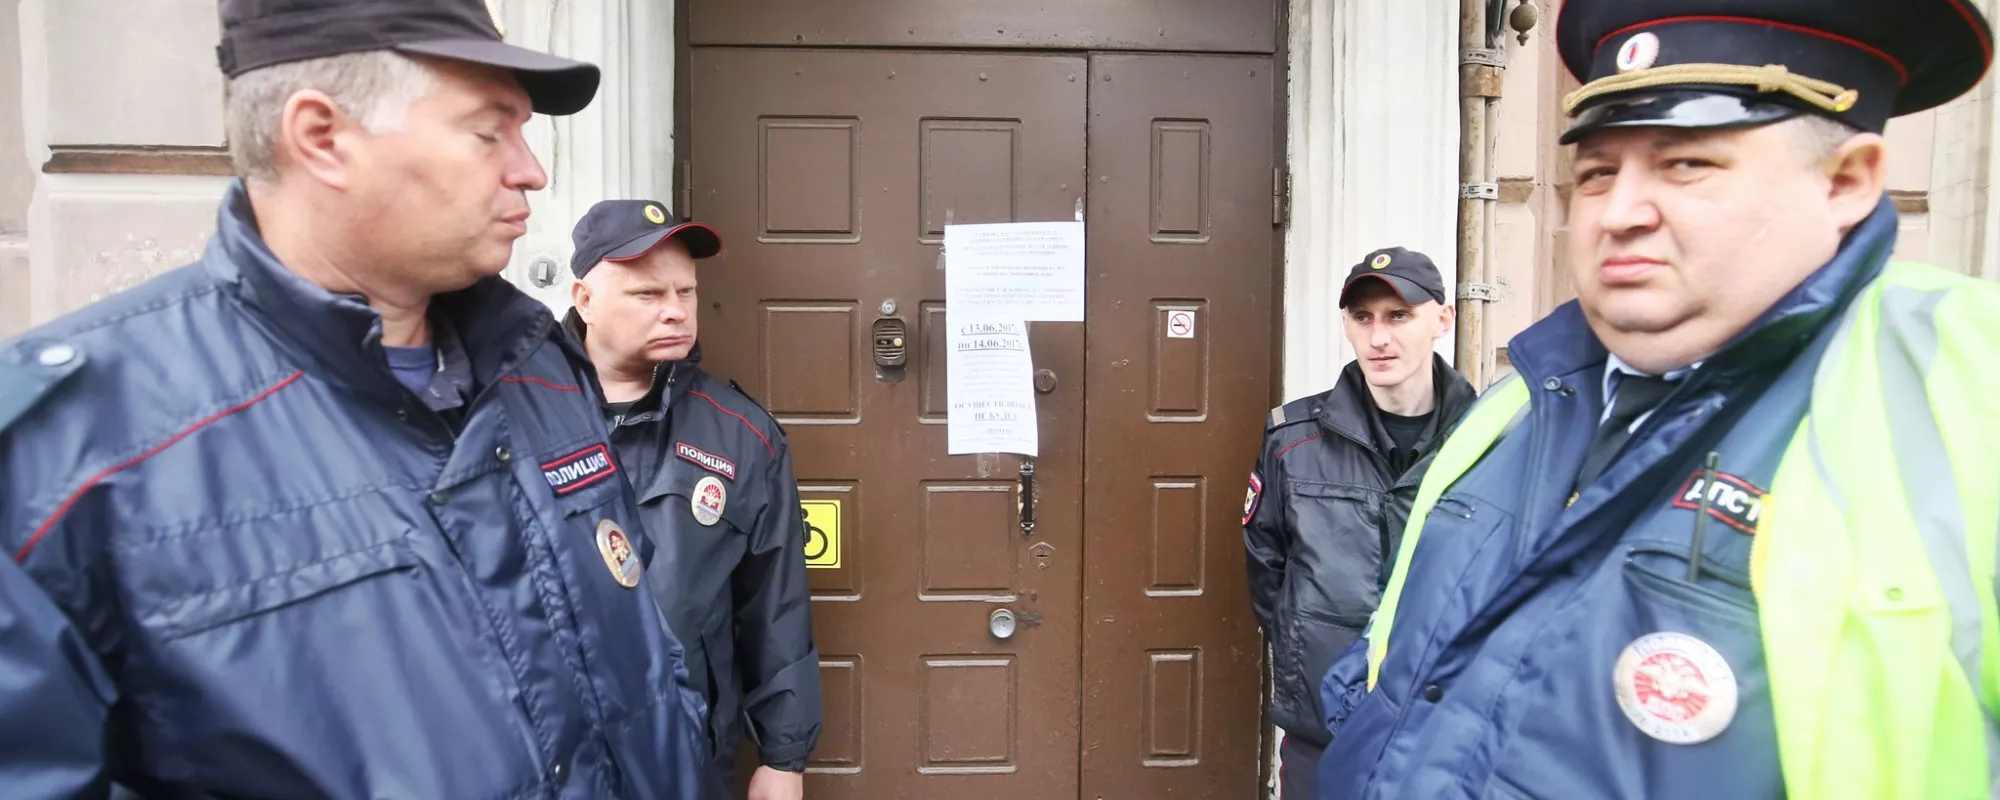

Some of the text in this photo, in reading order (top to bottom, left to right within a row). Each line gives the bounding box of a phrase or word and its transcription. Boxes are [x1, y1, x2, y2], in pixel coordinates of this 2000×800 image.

[958, 342, 970, 350] по
[544, 451, 608, 487] ПОЛИЦИЯ
[680, 445, 734, 475] ПОЛИЦИЯ
